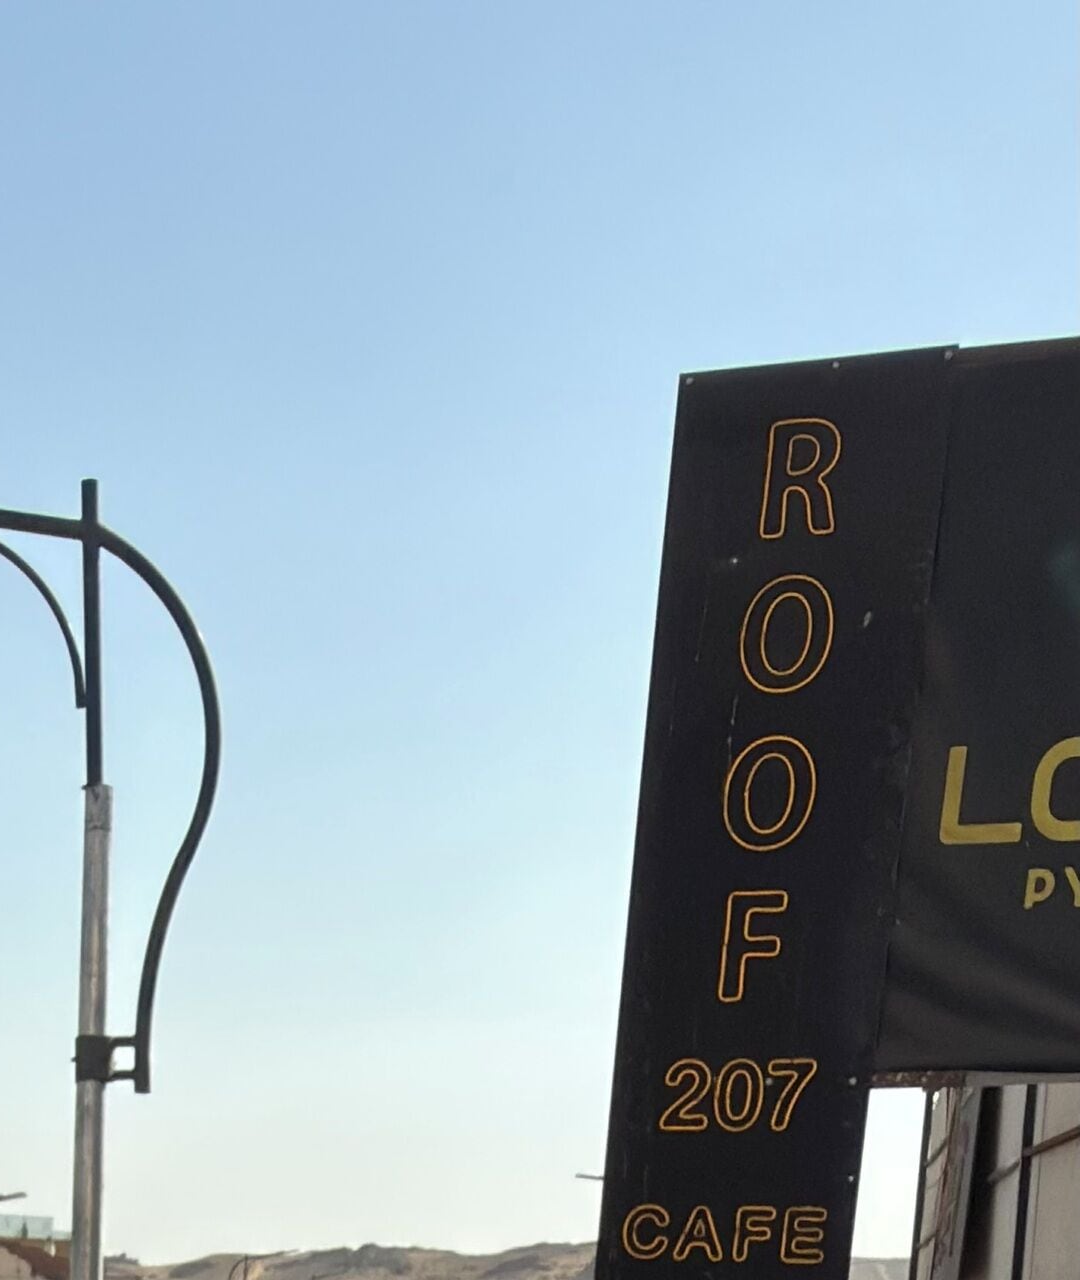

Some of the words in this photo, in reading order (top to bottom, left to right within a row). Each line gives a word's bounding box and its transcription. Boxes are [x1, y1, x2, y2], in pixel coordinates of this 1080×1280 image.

[719, 417, 842, 1003] ROOF
[659, 1058, 818, 1132] 207
[622, 1204, 828, 1264] CAFE
